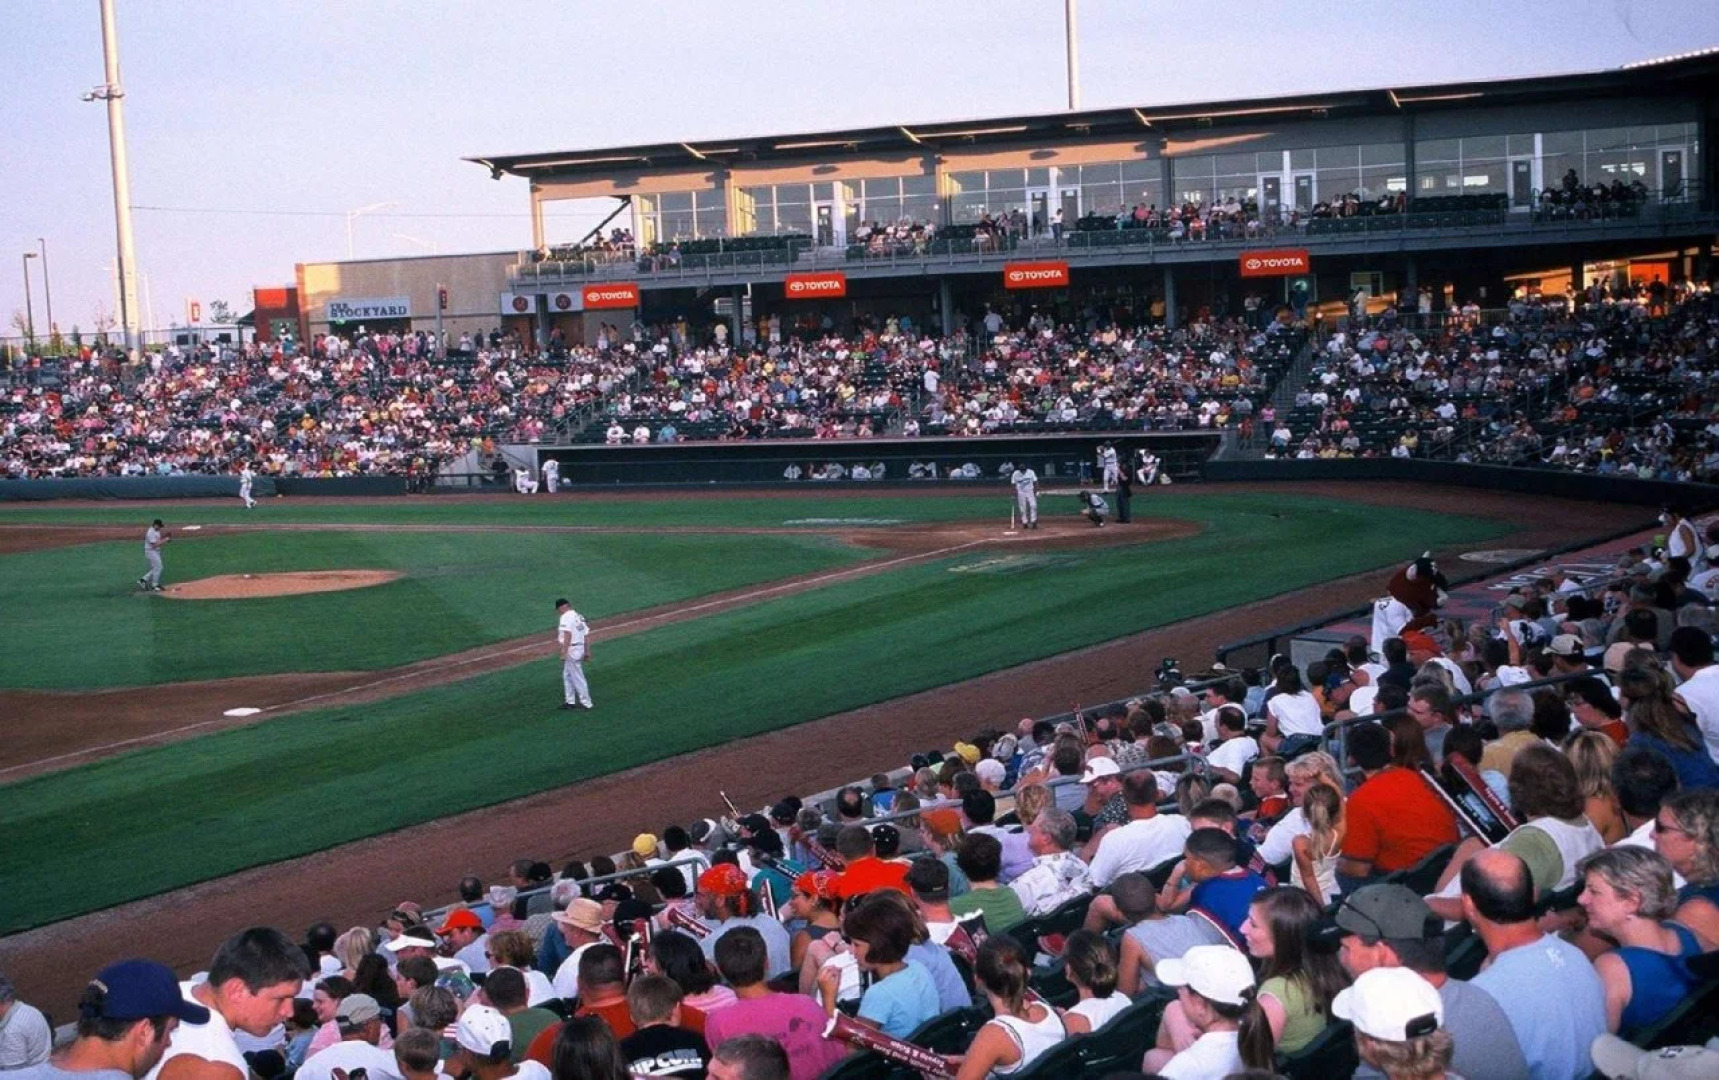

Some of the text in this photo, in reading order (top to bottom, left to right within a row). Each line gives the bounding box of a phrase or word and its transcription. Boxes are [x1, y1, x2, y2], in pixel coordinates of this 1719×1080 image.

[1262, 257, 1303, 267] TOYOTA
[1025, 269, 1062, 279] TOYOTA
[805, 280, 840, 290] TOYOTA
[600, 291, 634, 300] TOYOTA
[331, 305, 408, 318] STOCKYARD
